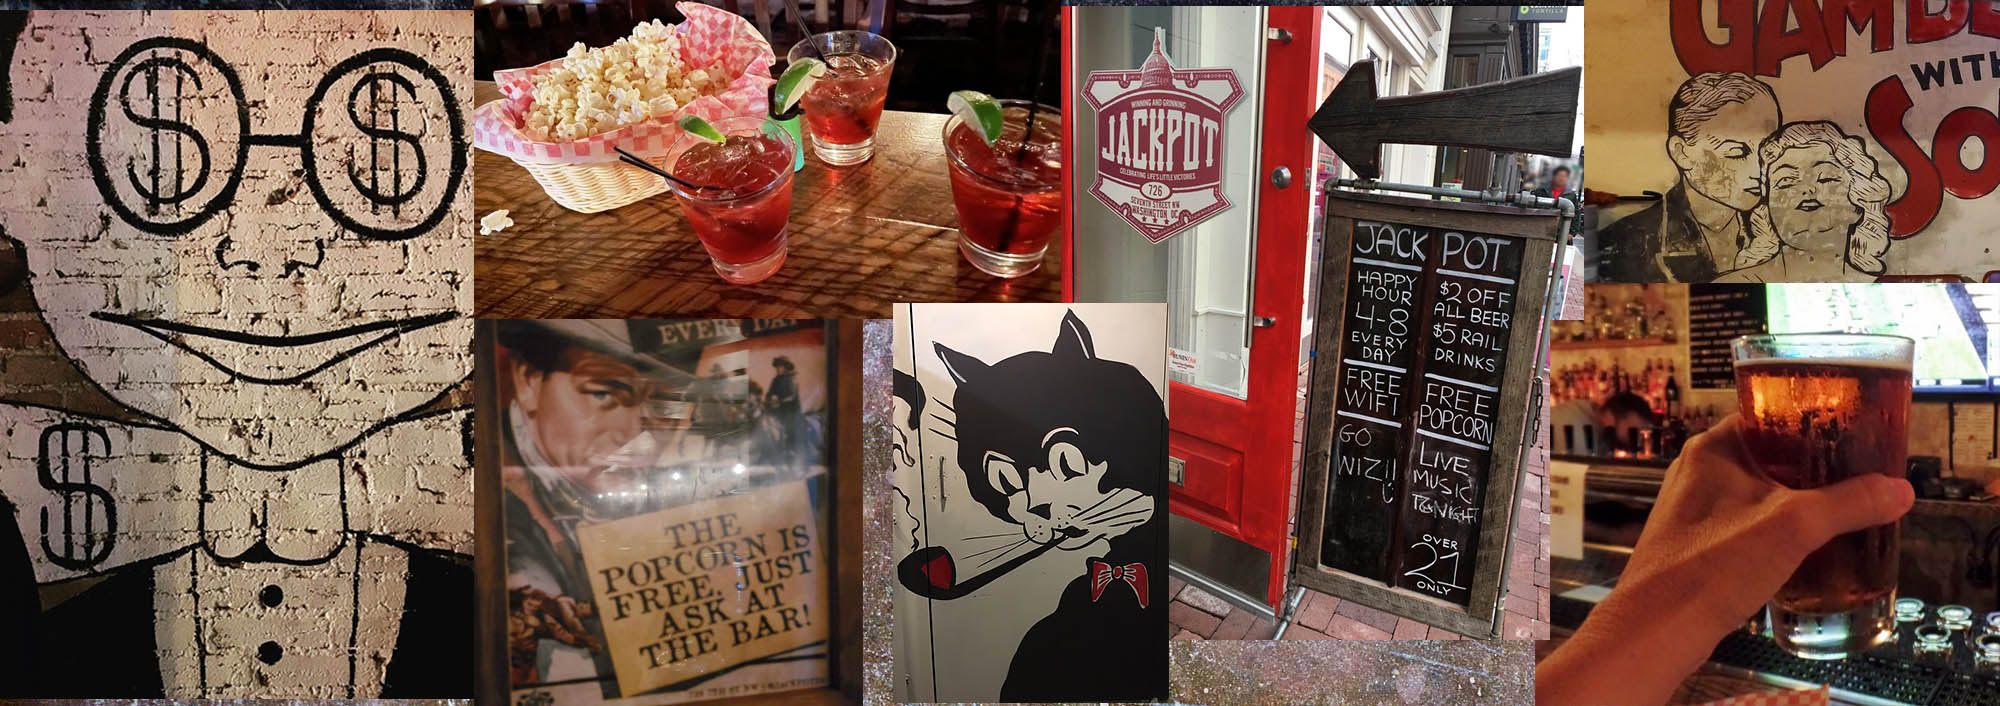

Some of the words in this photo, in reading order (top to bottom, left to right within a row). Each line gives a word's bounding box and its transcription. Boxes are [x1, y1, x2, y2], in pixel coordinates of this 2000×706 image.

[1152, 98, 1163, 106] AND
[1101, 108, 1219, 172] JACKPOT
[1130, 196, 1151, 207] SEVENTH
[1152, 200, 1171, 208] STREET
[1148, 184, 1163, 197] 726
[1356, 222, 1428, 262] JACK
[1443, 233, 1512, 272] POT
[1357, 271, 1418, 291] HAPPY
[1362, 284, 1412, 306] HOUR
[1440, 280, 1462, 304] $2
[1467, 288, 1511, 308] OFF
[1355, 302, 1409, 336] 4-8
[1434, 303, 1465, 319] ALL
[1470, 308, 1510, 329] BEER
[1352, 331, 1408, 350] EVERY
[1433, 322, 1456, 344] $5
[1461, 328, 1503, 351] RAIL
[1363, 346, 1396, 363] DAY
[1435, 348, 1496, 373] DRINKS
[1347, 368, 1402, 396] FREE
[1344, 388, 1398, 416] WIFI
[1425, 383, 1492, 418] FREE
[1339, 424, 1372, 447] GO
[1419, 404, 1494, 445] POPCORN
[1420, 441, 1471, 476] LIVE
[1413, 469, 1473, 505] MUSIC
[664, 513, 742, 549] THE
[1422, 533, 1458, 550] OVER
[599, 531, 767, 594] POPCORN
[778, 524, 811, 551] IS
[735, 550, 813, 591] JUST
[1404, 542, 1467, 590] 21
[1416, 581, 1452, 596] ONLY
[659, 598, 731, 638] ASK
[744, 583, 787, 617] AT
[638, 630, 718, 670] THE
[731, 604, 813, 648] BAR!
